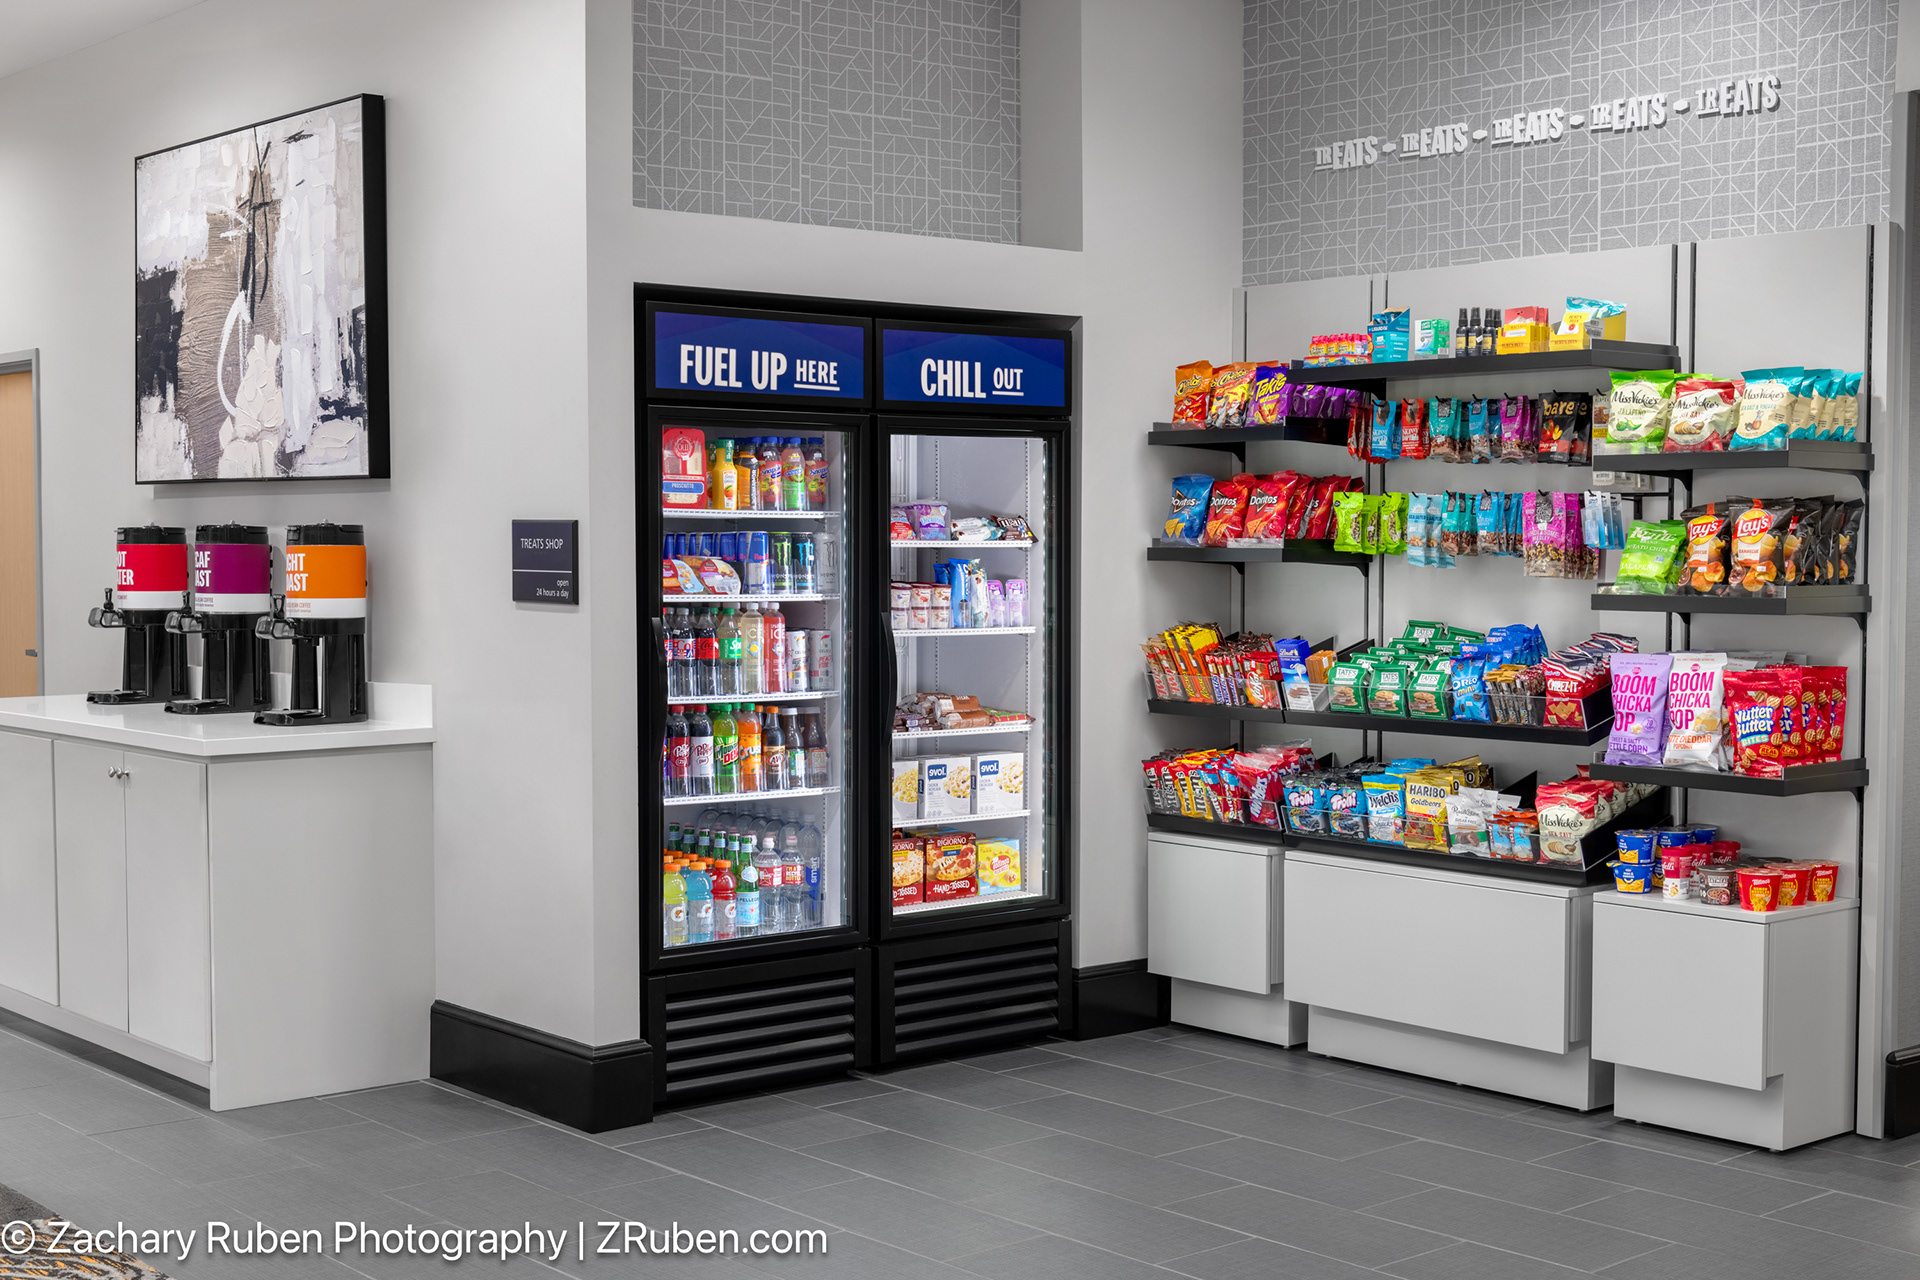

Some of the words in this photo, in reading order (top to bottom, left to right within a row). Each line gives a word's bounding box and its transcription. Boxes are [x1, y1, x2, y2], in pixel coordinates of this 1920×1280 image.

[1314, 135, 1378, 171] TREATS
[1400, 122, 1469, 159] TREATS
[1491, 107, 1566, 147] TREATS
[1590, 91, 1668, 132] TREATS
[1695, 74, 1781, 118] TREATS
[680, 344, 742, 388] FUEL
[750, 350, 788, 392] UP
[796, 360, 838, 385] HERE
[920, 358, 986, 398] CHILL
[993, 367, 1023, 390] OUT
[1256, 376, 1287, 402] Takis
[1543, 399, 1575, 416] bare
[1612, 392, 1631, 404] Miss
[1631, 390, 1658, 408] Vickie's
[1250, 495, 1278, 506] Doritos
[1689, 521, 1719, 540] Lay's
[1737, 516, 1770, 537] Lay's
[520, 538, 544, 549] TREATS
[546, 538, 564, 550] SHOP
[118, 551, 127, 568] OT
[195, 551, 210, 568] CAF
[196, 570, 212, 587] AST
[536, 588, 542, 596] 24
[543, 588, 556, 597] hours
[560, 590, 569, 599] day
[1453, 677, 1477, 689] OREO
[1612, 674, 1657, 696] BOOM
[1670, 672, 1715, 692] BOOM
[1457, 686, 1475, 696] mini
[1612, 694, 1651, 712] CHICKA
[1669, 692, 1710, 708] CHICKA
[1614, 711, 1636, 732] OP
[1669, 709, 1694, 730] POP
[1735, 706, 1774, 722] Nutter
[1736, 720, 1774, 738] Butter
[1609, 742, 1627, 752] ETTLE
[1628, 744, 1648, 753] CORN
[1680, 735, 1712, 743] CHEDDAR
[1742, 735, 1768, 747] BITES
[1409, 784, 1446, 798] HARIBO
[1368, 792, 1399, 808] Welch's
[1410, 798, 1442, 808] Goldbears
[1540, 814, 1556, 826] Miss
[1556, 814, 1583, 830] Vickie's
[893, 842, 914, 851] GIORNO
[893, 887, 917, 898] D-TOSSED
